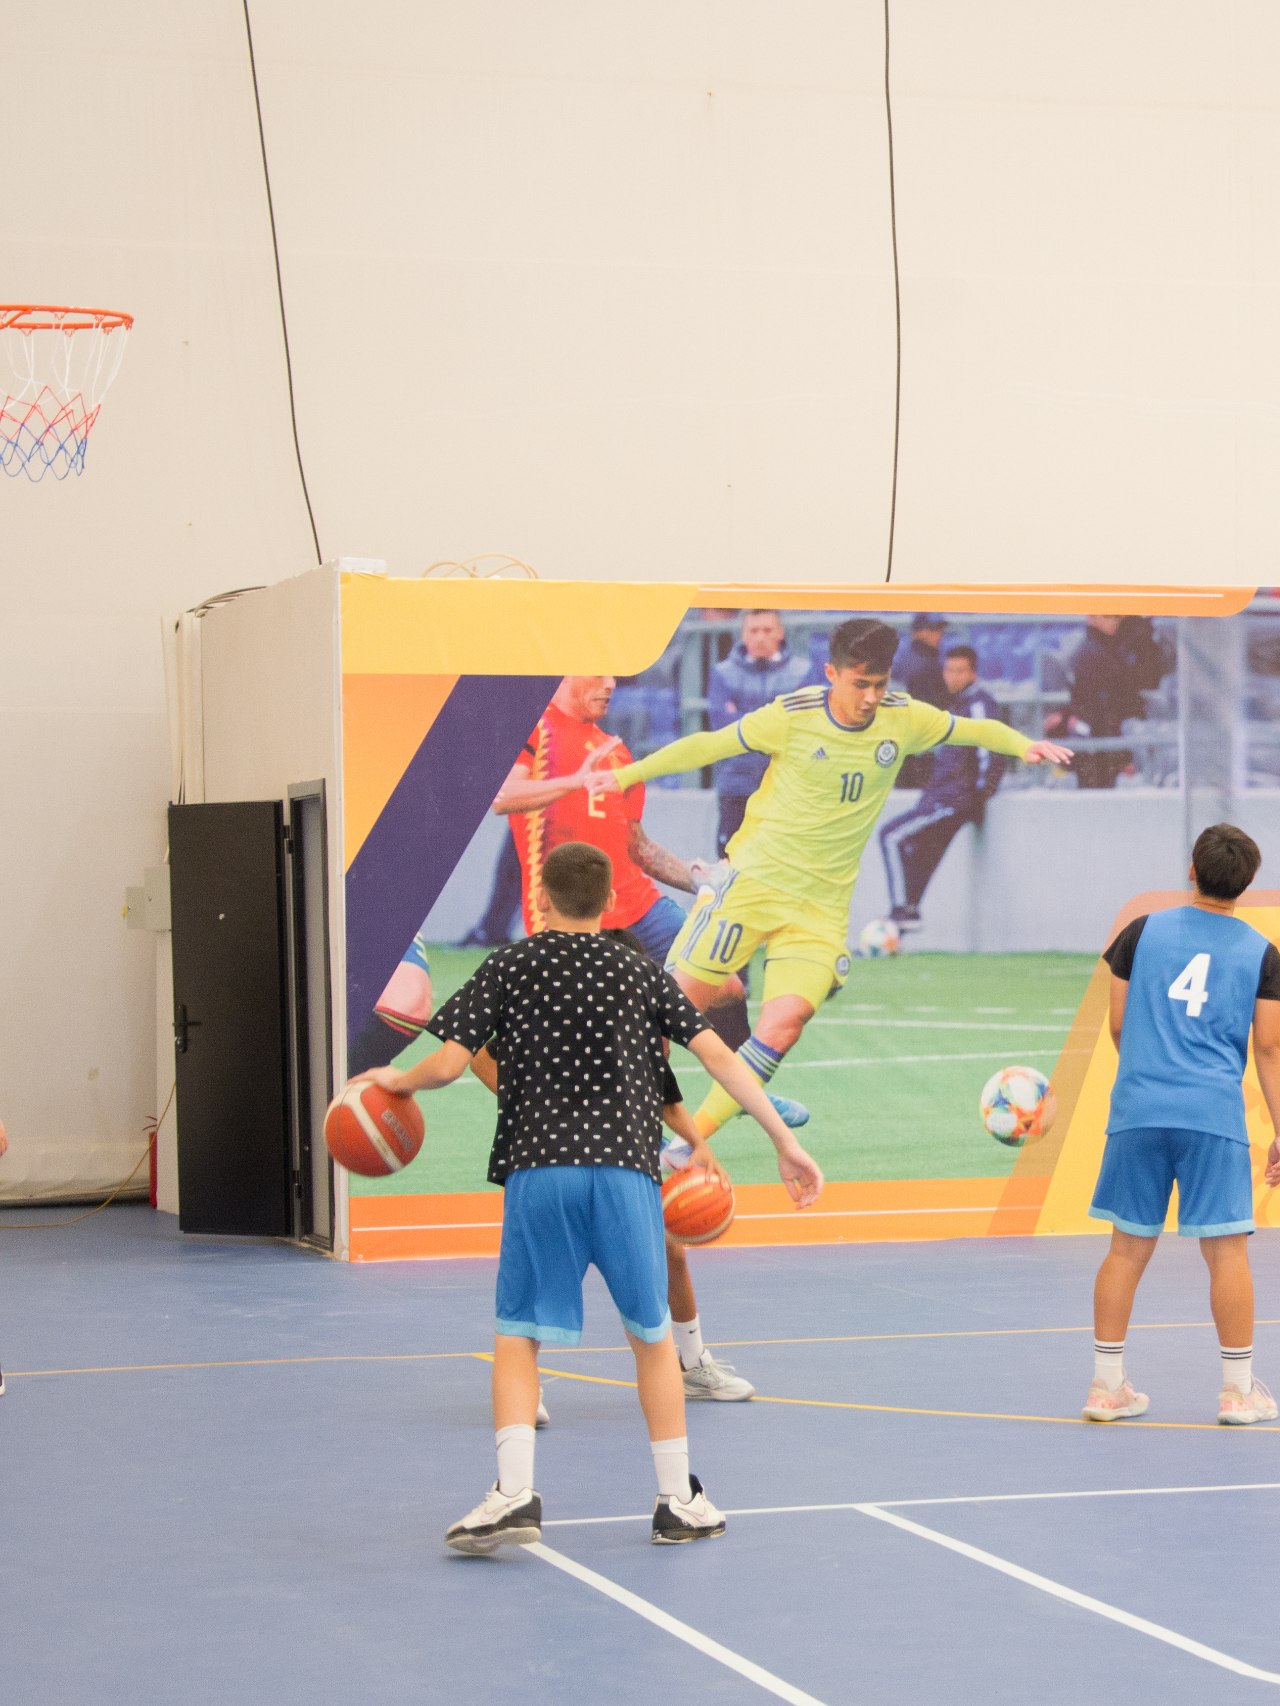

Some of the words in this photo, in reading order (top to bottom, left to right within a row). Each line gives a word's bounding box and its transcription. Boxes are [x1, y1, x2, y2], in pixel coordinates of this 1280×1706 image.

[840, 771, 864, 803] 10
[710, 919, 743, 963] 10
[1168, 953, 1211, 1017] 4
